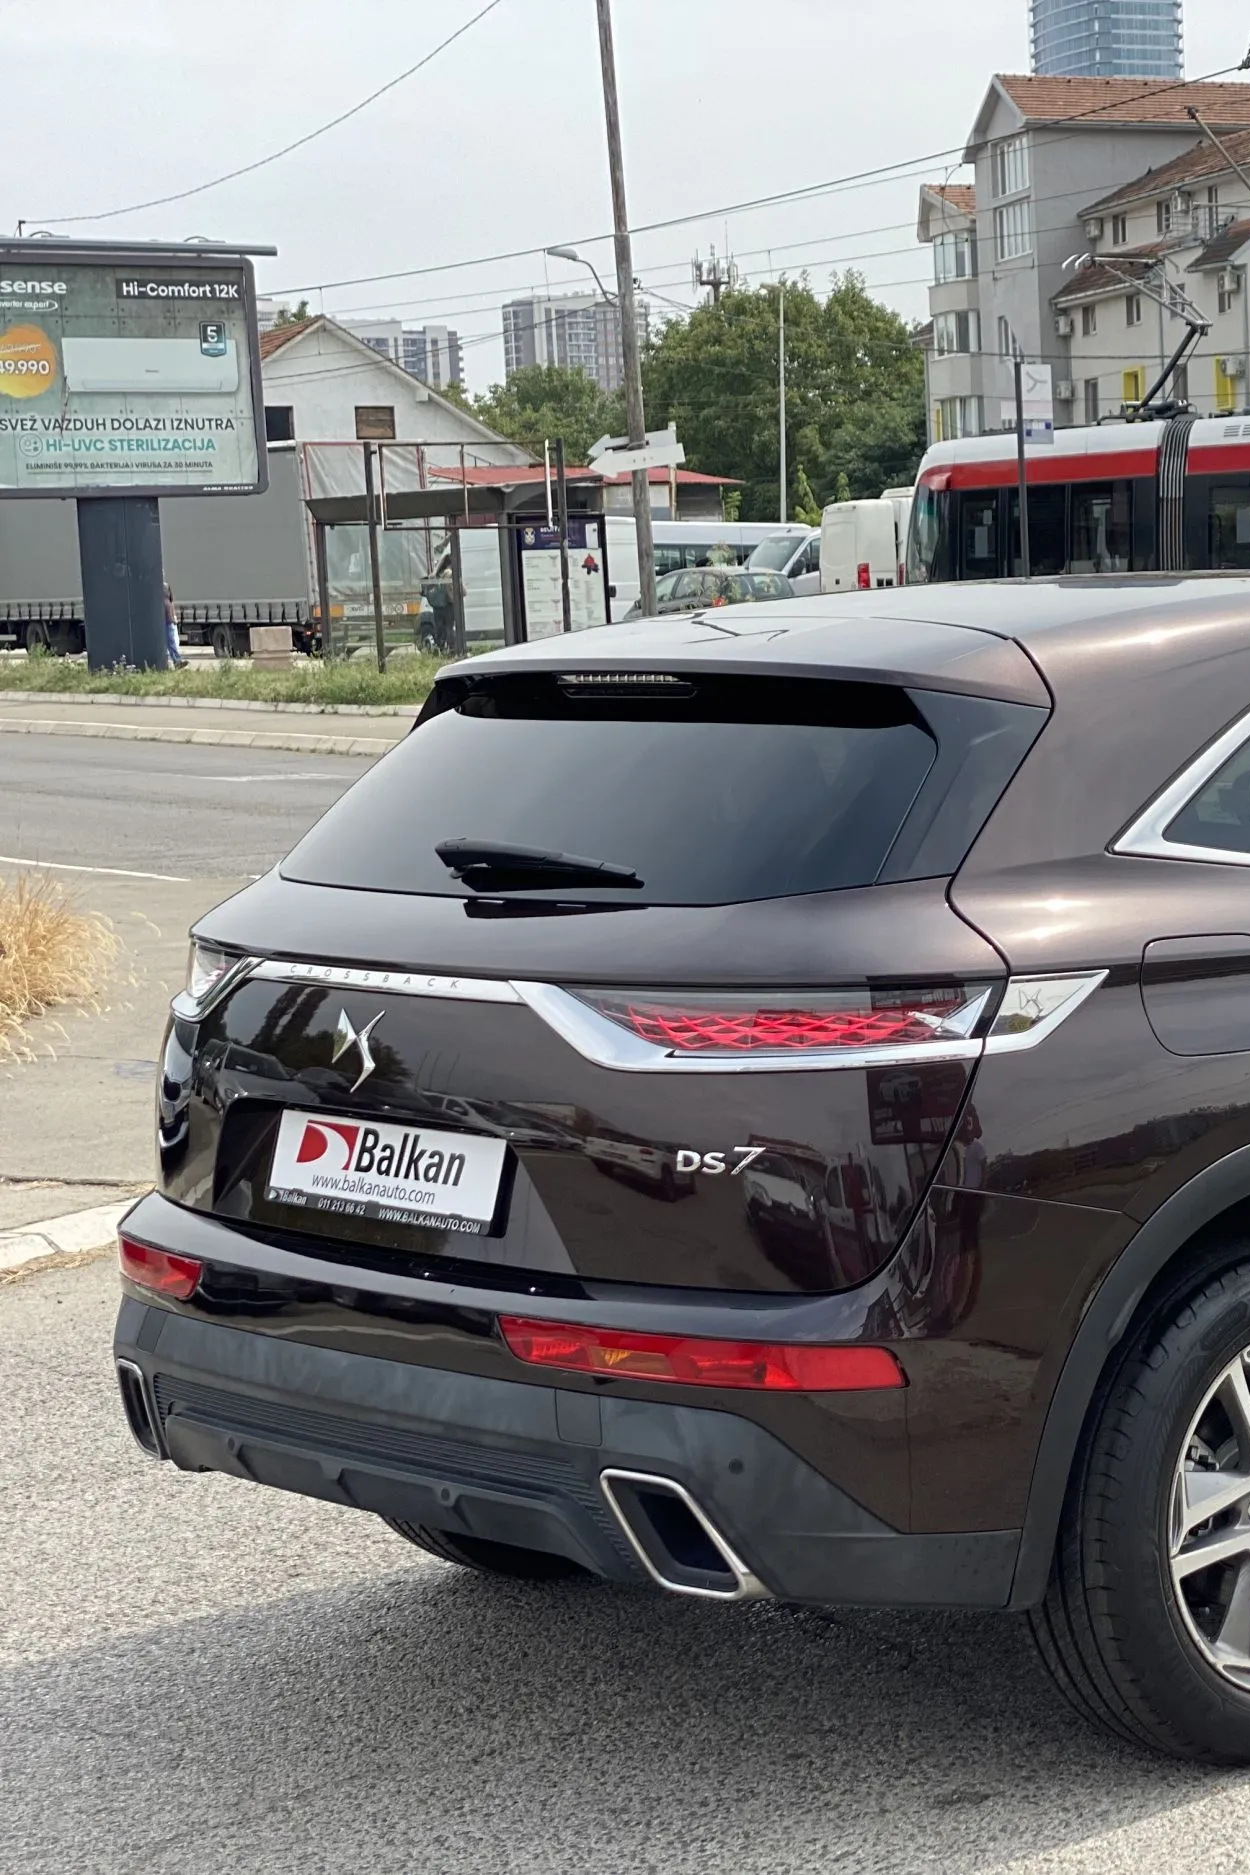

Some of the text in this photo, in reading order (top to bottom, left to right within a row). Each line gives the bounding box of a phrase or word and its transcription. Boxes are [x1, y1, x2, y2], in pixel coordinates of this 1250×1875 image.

[122, 281, 239, 298] Hi-Comfort 12K
[206, 325, 218, 343] 5
[0, 415, 235, 431] SVEŽ VAZDUH DOLAZI IZNUTRA
[46, 438, 216, 452] HI-UVC STERILIZACIJA
[90, 462, 129, 470] BAKTERIJA
[135, 461, 162, 469] VIRUSA
[163, 461, 173, 469] ZA
[174, 461, 184, 469] 30
[185, 461, 213, 469] MINUTA
[289, 965, 460, 989] CROSSBACK
[354, 1127, 466, 1187] Balkan
[311, 1172, 436, 1205] www.balkanauto.com
[283, 1190, 481, 1234] Balkan 011 213 66 42 WWW.BALKANAUTO.COM
